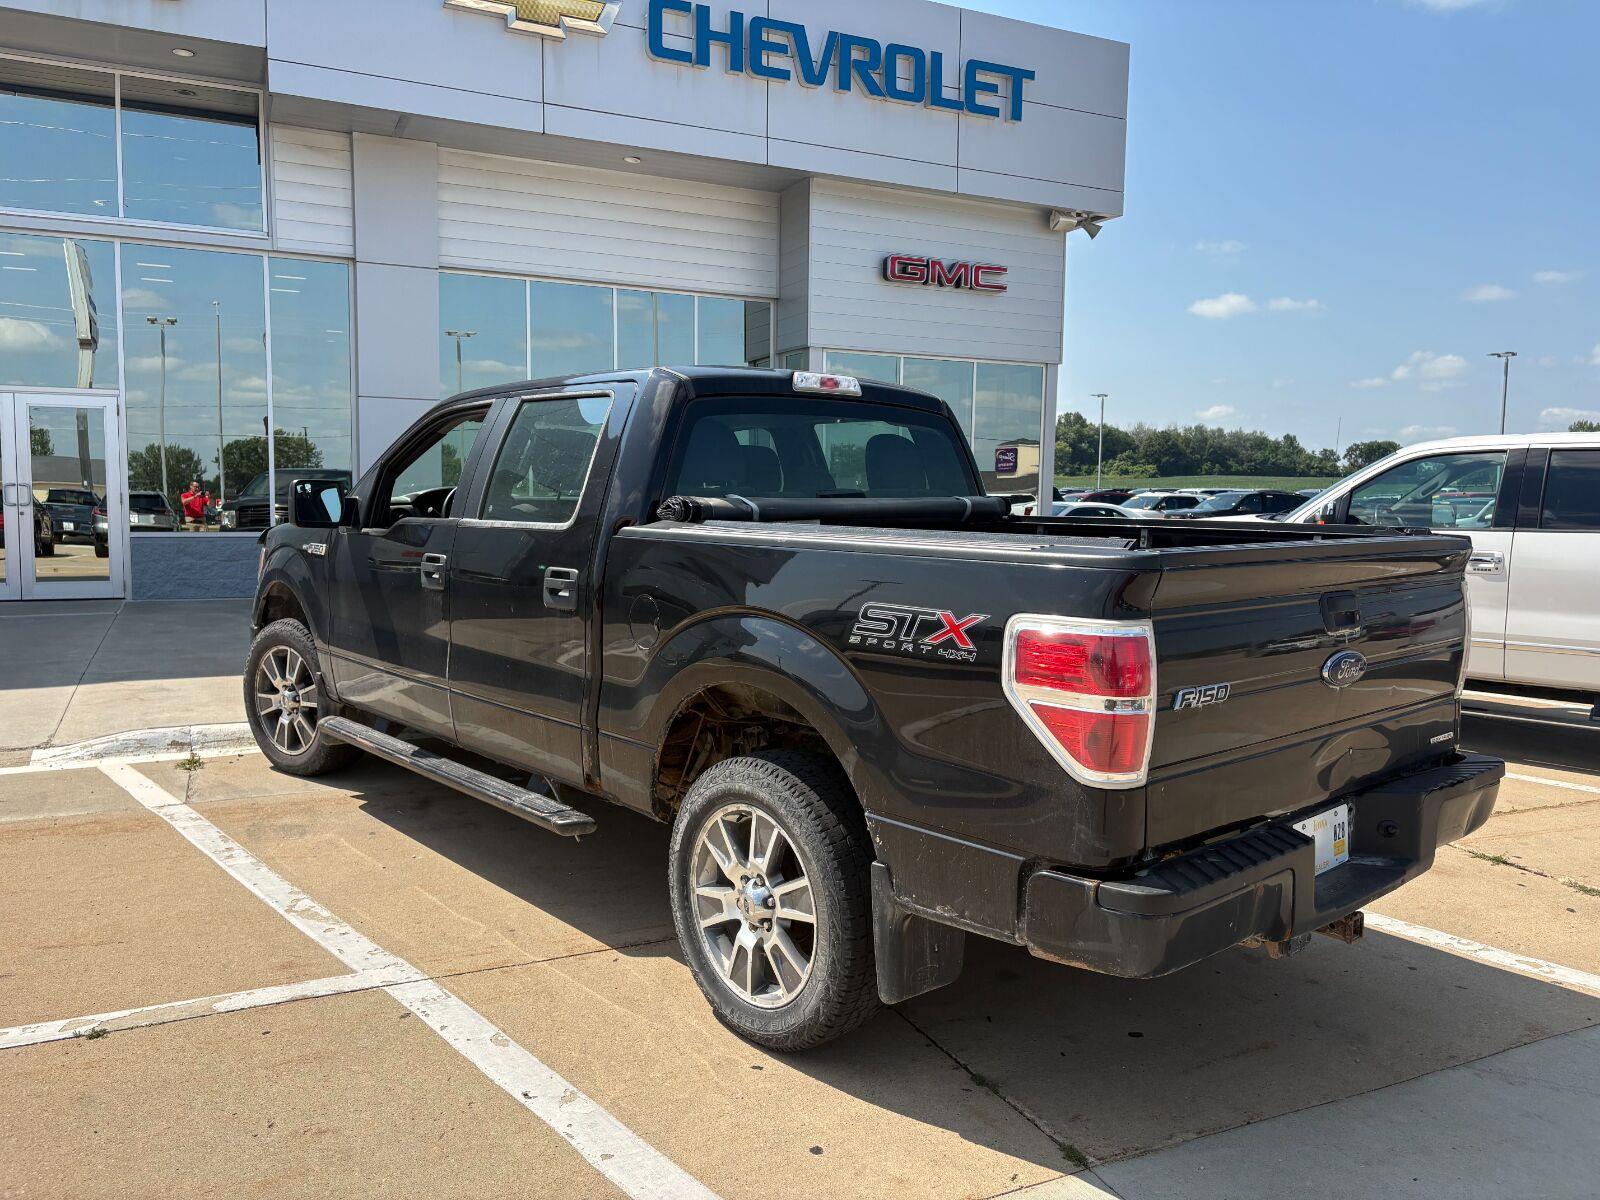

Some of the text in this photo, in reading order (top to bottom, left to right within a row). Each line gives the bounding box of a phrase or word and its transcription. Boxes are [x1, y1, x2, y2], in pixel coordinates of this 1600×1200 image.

[648, 0, 1036, 122] CHEVROLET
[885, 254, 1008, 292] GMC
[849, 635, 933, 654] SPORT
[852, 602, 992, 650] STX
[1337, 658, 1362, 680] Ford
